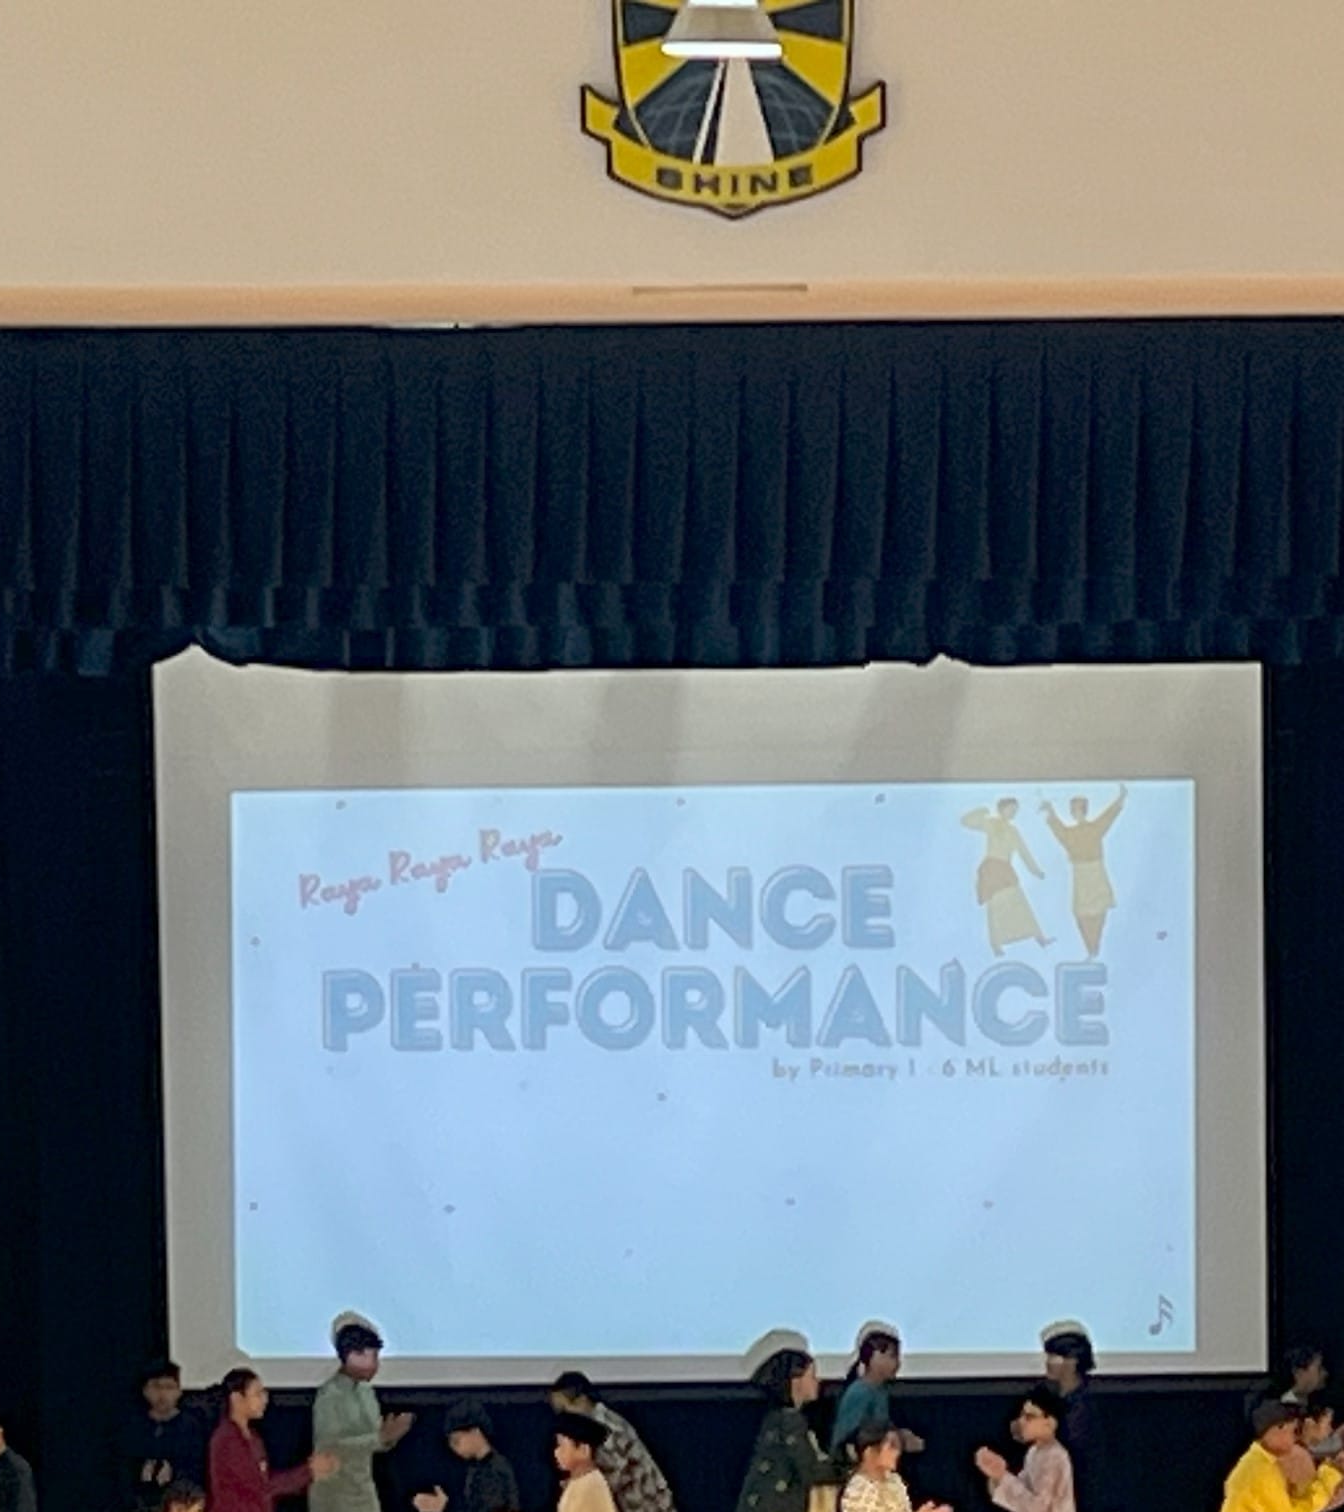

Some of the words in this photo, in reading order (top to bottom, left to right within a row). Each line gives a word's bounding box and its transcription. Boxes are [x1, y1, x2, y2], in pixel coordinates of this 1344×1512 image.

[656, 165, 814, 196] SHINE
[299, 873, 383, 917] Raya
[389, 850, 472, 894] Raya
[479, 828, 563, 872] Raya
[531, 864, 897, 953] DANCE
[321, 961, 1111, 1052] PERFORMANCE
[772, 1057, 799, 1081] by
[809, 1057, 897, 1081] Primary
[941, 1057, 956, 1078] 6
[966, 1058, 1001, 1077] ML
[1012, 1055, 1109, 1078] students
